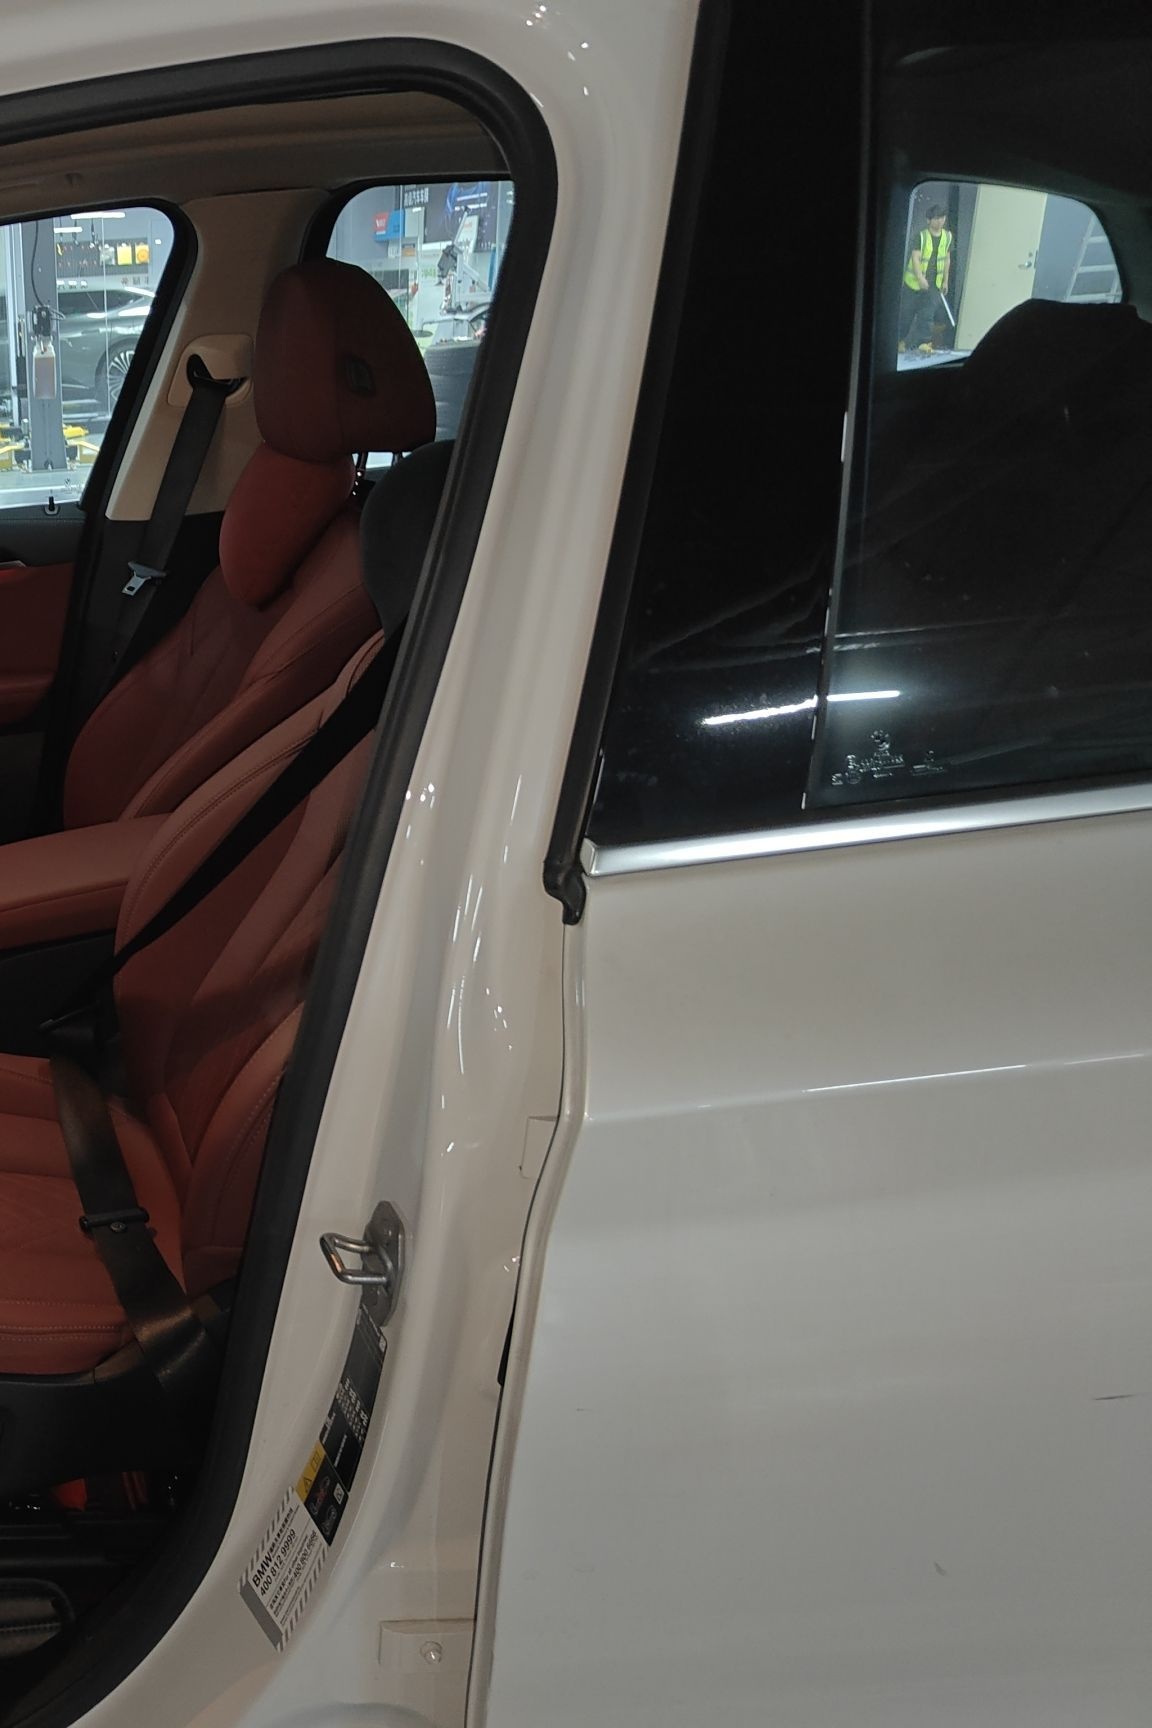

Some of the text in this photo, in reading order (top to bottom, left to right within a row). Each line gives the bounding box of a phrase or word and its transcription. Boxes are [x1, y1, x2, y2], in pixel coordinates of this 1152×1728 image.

[252, 1552, 273, 1587] BMW
[260, 1575, 273, 1596] 400
[270, 1555, 283, 1577] 812
[280, 1528, 296, 1558] 9999
